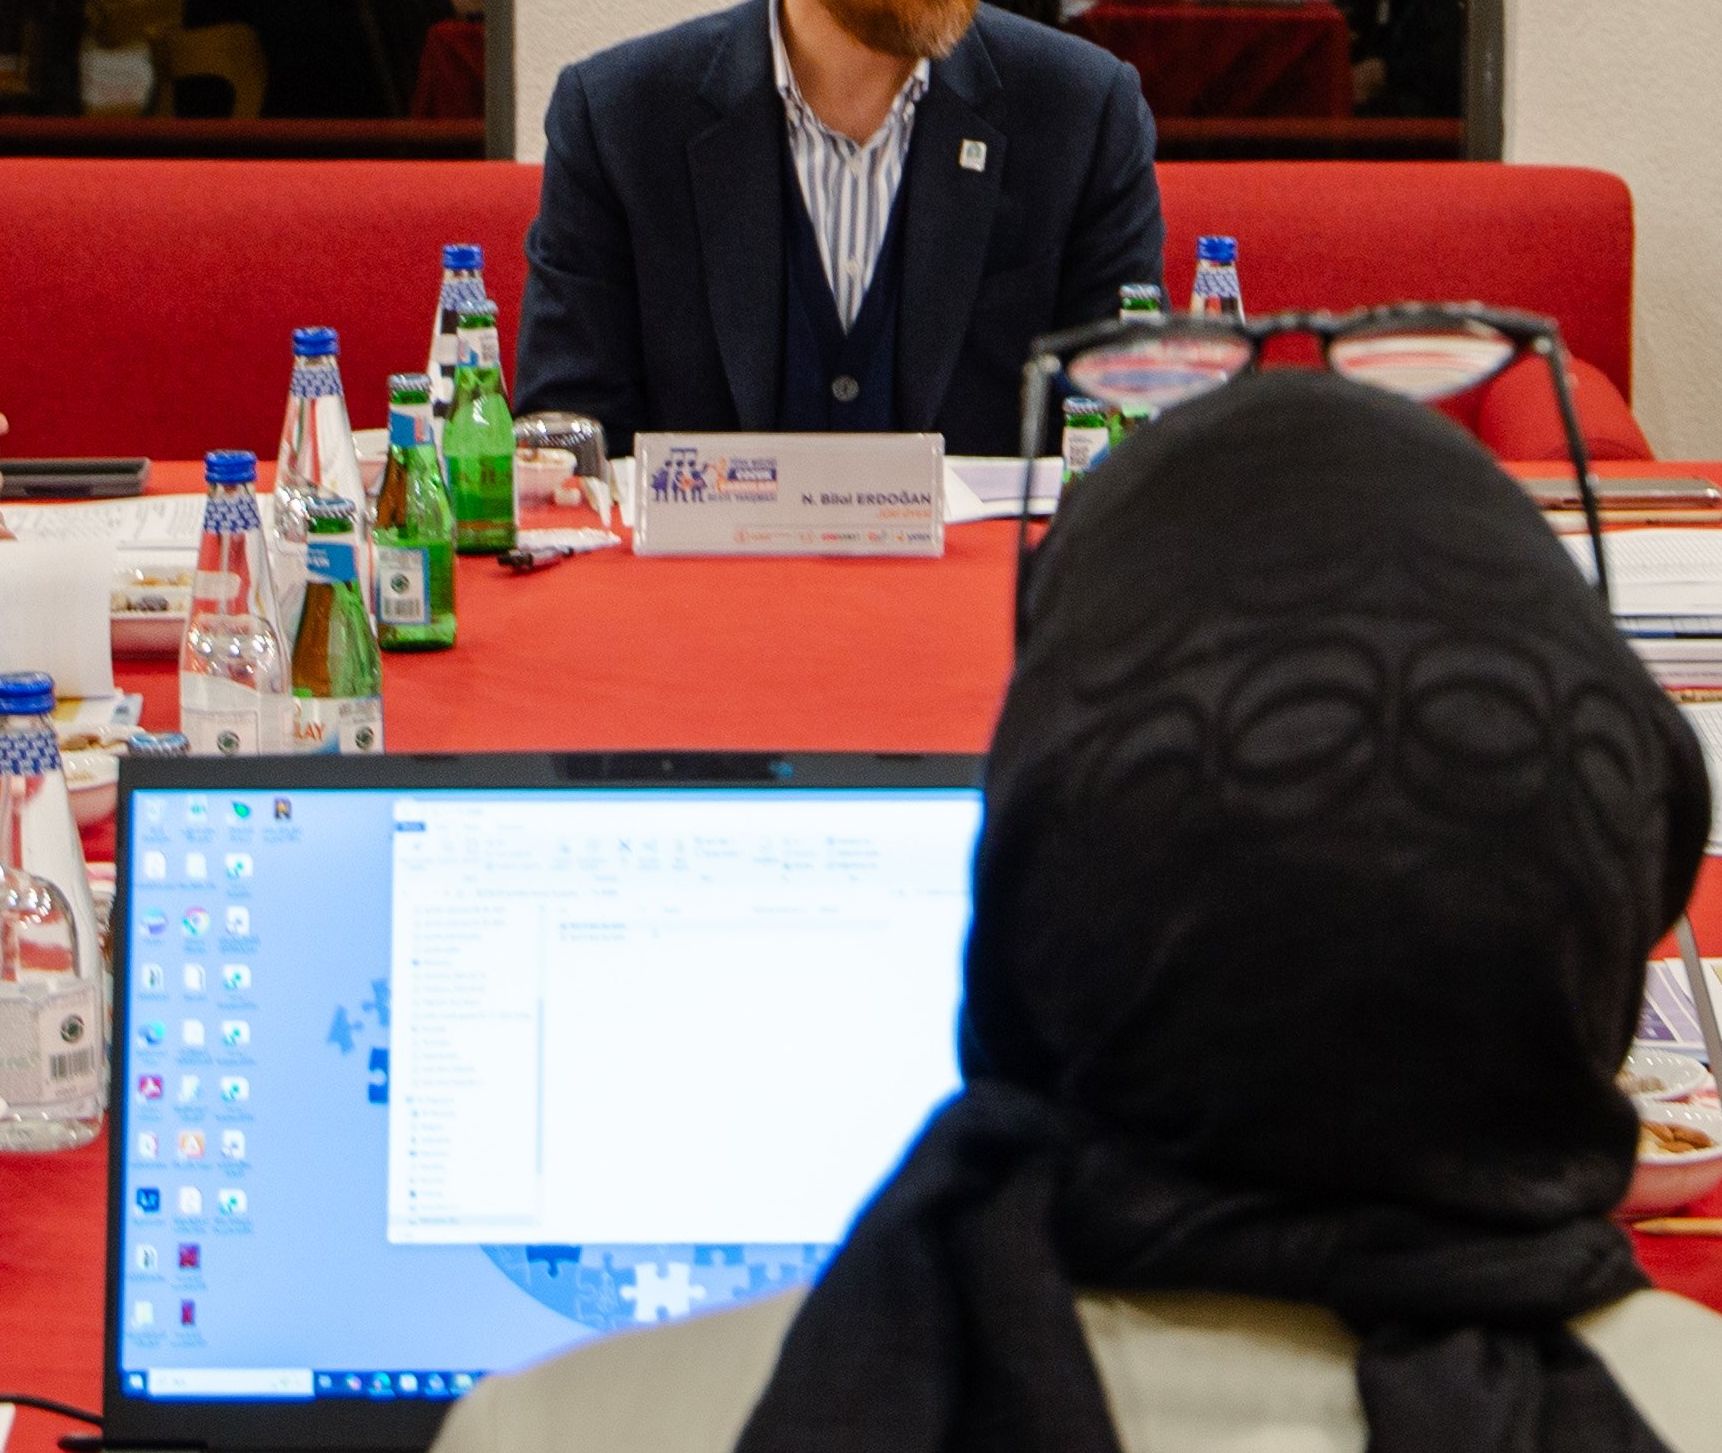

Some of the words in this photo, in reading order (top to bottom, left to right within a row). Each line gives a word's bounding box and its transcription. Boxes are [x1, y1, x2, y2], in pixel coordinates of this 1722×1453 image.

[801, 493, 817, 505] N.
[820, 492, 853, 506] Bilal
[856, 490, 932, 506] ERDOĞAN
